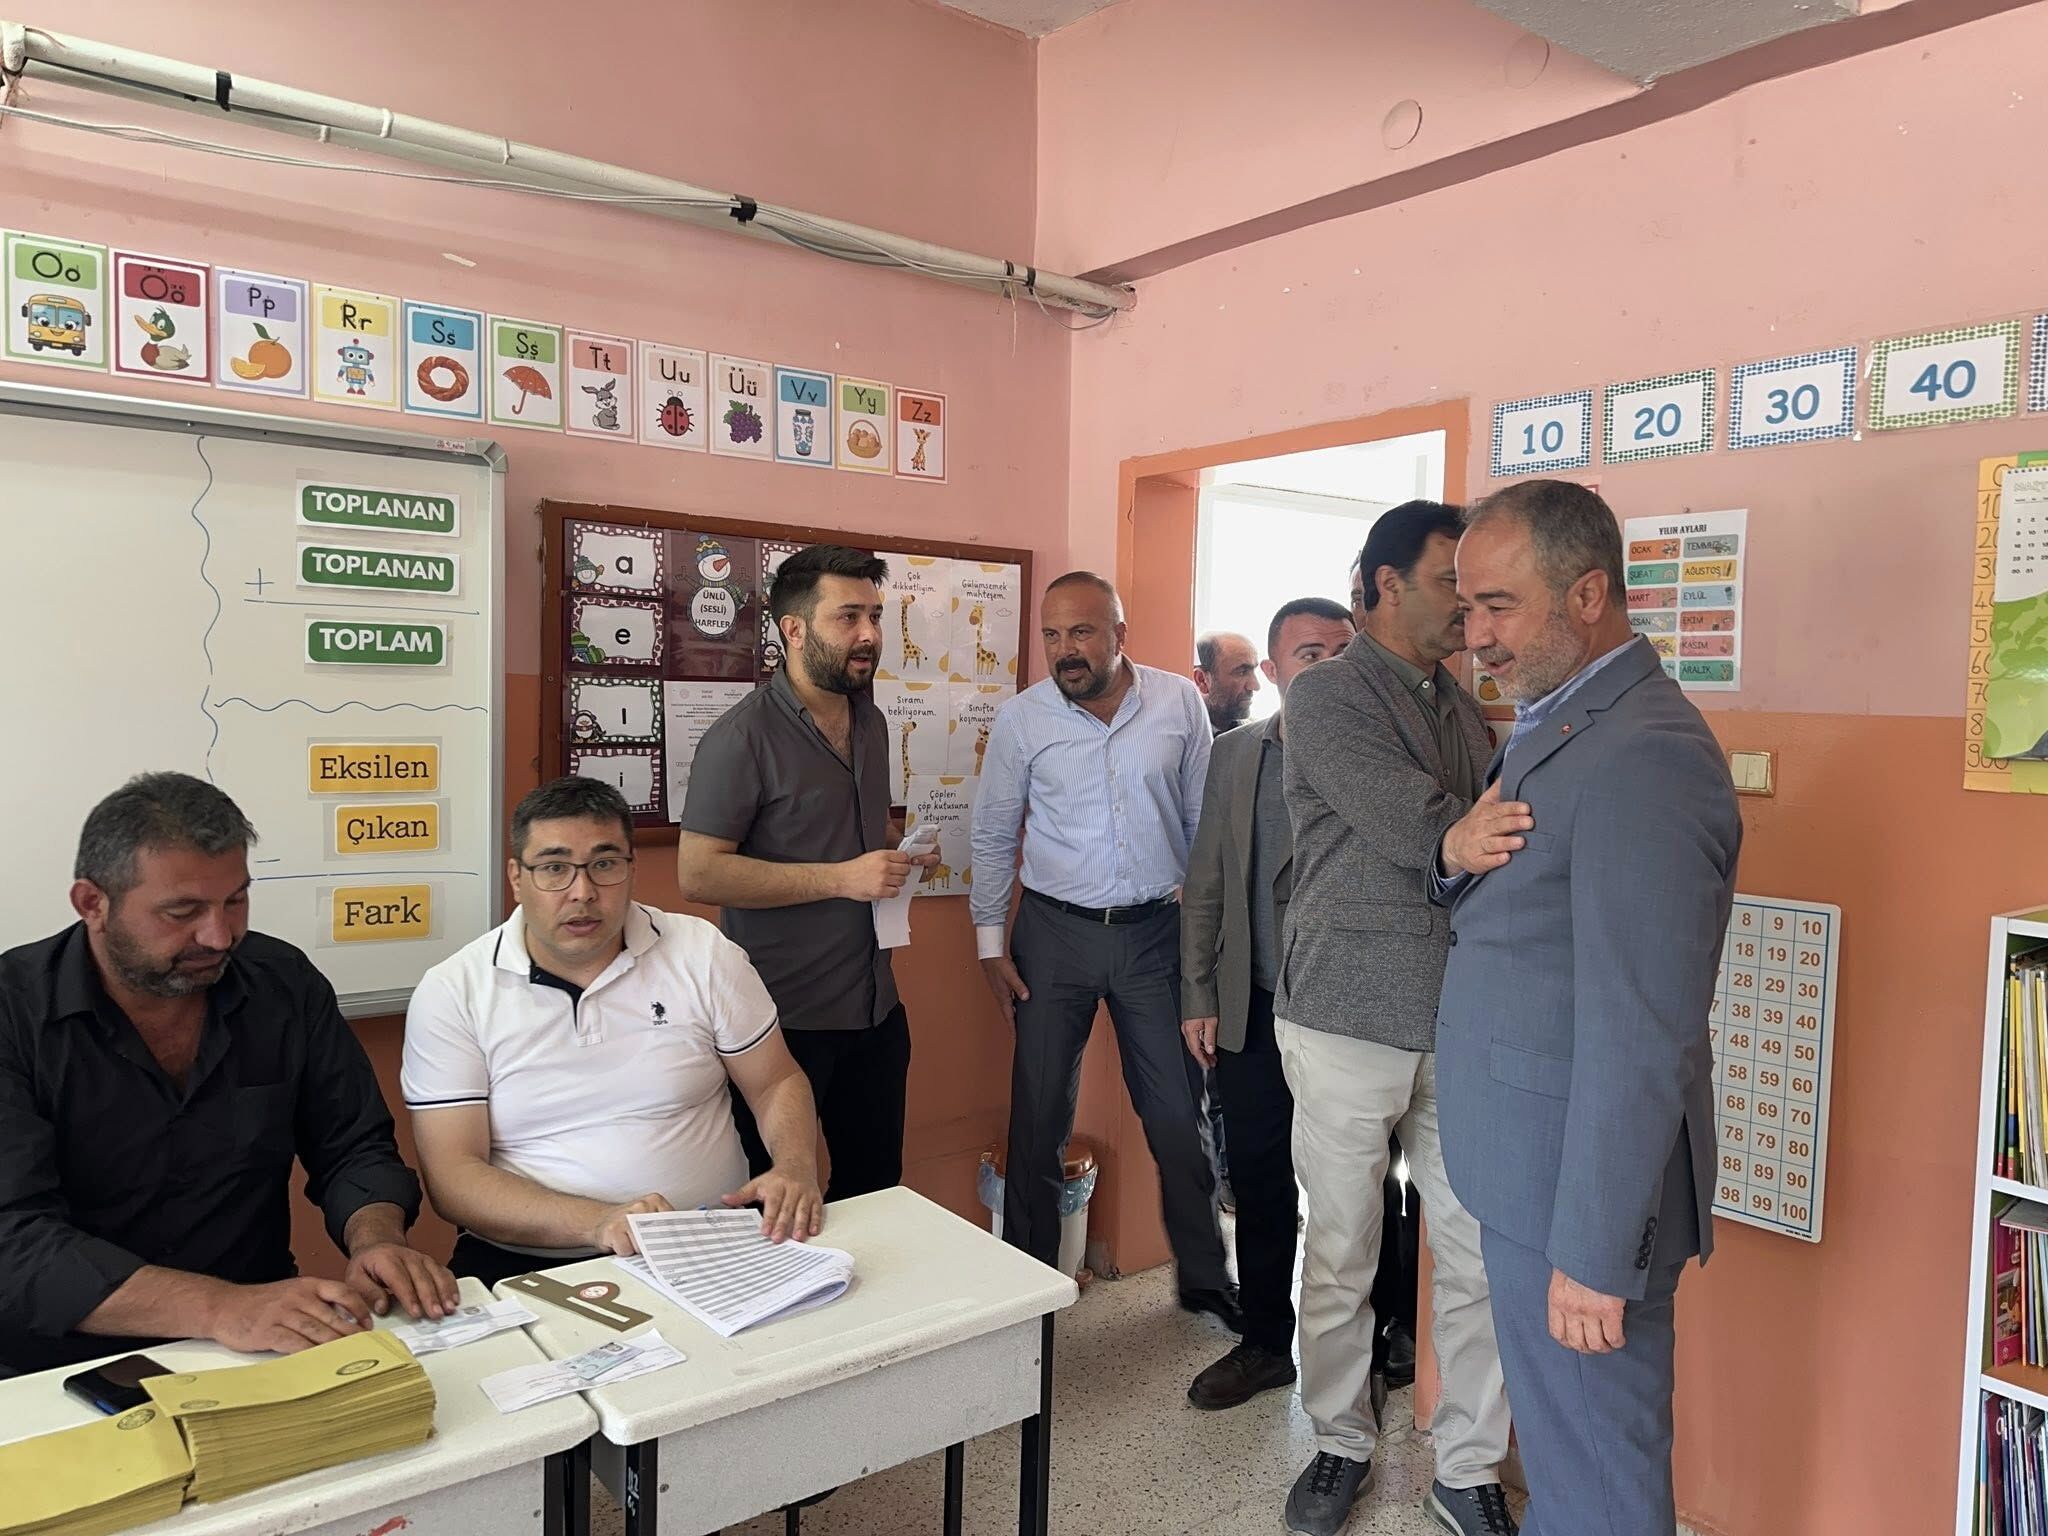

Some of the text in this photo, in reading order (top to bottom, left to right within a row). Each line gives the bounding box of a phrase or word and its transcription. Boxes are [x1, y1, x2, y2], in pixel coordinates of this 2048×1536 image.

[32, 251, 81, 283] Oo
[248, 286, 276, 318] Pp
[342, 302, 372, 331] Rr
[431, 320, 456, 346] Ss
[515, 332, 539, 361] Şş
[589, 346, 611, 371] Tt
[660, 358, 690, 384] Uu
[728, 366, 757, 397] Üü
[1909, 359, 1977, 402] 40
[791, 379, 818, 403] Vv
[855, 387, 876, 414] Yy
[1765, 383, 1820, 425] 30
[912, 401, 932, 423] Zz
[1633, 402, 1682, 442] 20
[1522, 420, 1563, 455] 10
[311, 491, 445, 522] TOPLANAN
[1658, 523, 1708, 536] YILIN AYLARI
[1631, 545, 1652, 555] OCAK
[311, 552, 445, 581] TOPLANAN
[615, 555, 633, 576] a
[907, 571, 921, 582] Çok
[702, 589, 726, 601] ÜNLÜ
[961, 578, 1008, 591] Gülümsemek
[1683, 590, 1707, 601] EYLÜL
[700, 603, 727, 616] (SESLİ)
[1628, 593, 1651, 603] MART
[614, 628, 631, 645] e
[695, 618, 731, 629] HARFLER
[319, 628, 433, 654] TOPLAM
[1681, 640, 1708, 650] KASIM
[1682, 665, 1712, 675] ARALIK
[896, 694, 924, 705] Sıramı
[319, 754, 430, 781] Eksilen
[618, 771, 624, 788] i
[929, 788, 957, 803] Çöpleri
[933, 799, 969, 811] kutusuna
[346, 814, 430, 847] Çıkan
[344, 895, 422, 927] Fark
[1742, 912, 1822, 936] 8 9 10
[1735, 942, 1821, 968] 18 19 20
[1733, 972, 1819, 1000] 28 29 30
[1731, 1002, 1752, 1020] 38
[1763, 1009, 1784, 1025] 39
[1795, 1014, 1818, 1032] 40
[1729, 1033, 1750, 1050] 48
[1761, 1039, 1783, 1056] 49
[1794, 1044, 1816, 1062] 50
[1727, 1064, 1814, 1094] 58 59 60
[1726, 1094, 1812, 1127] 68 69 70
[1724, 1124, 1810, 1158] 78 79 80
[1722, 1155, 1808, 1189] 88 89 90
[1721, 1186, 1809, 1222] 98 99 100
